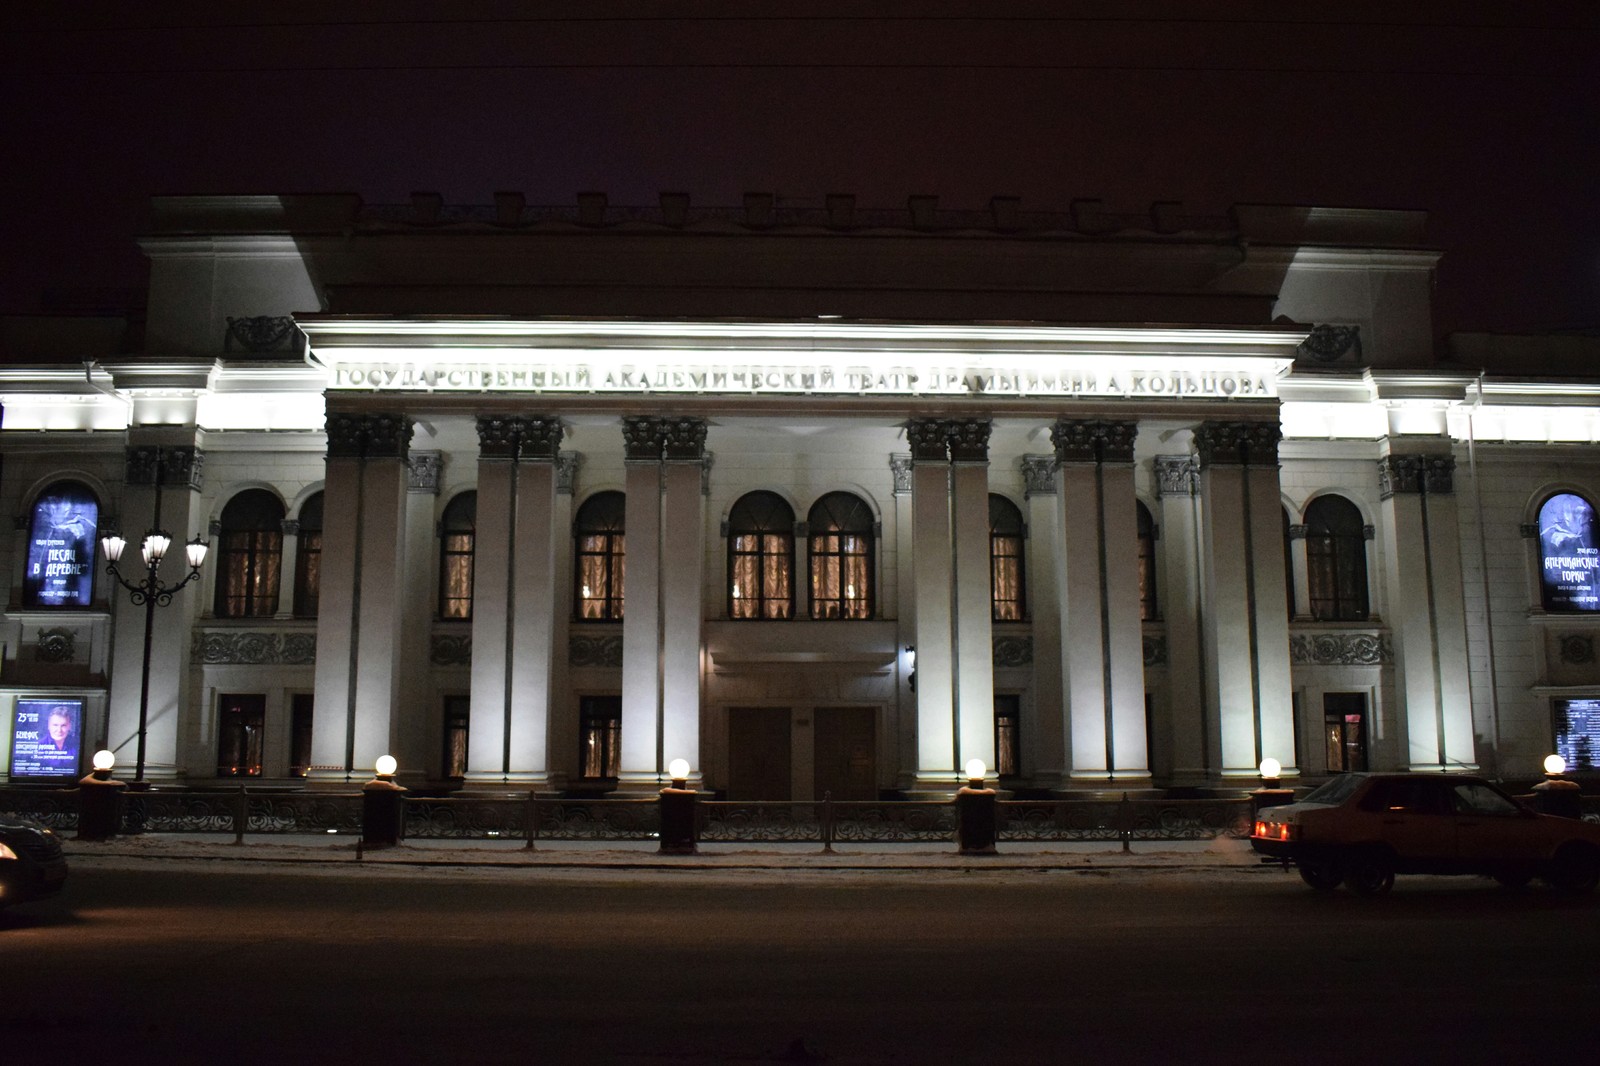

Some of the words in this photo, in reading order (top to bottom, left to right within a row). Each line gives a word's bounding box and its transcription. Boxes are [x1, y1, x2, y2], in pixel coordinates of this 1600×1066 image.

[335, 367, 592, 388] ГОСУДАРСТВЕННЫЙ
[603, 370, 834, 389] АКАДЕМИЧЕСКИЙ
[845, 373, 920, 391] ТЕАТР
[927, 374, 1021, 392] ДРАМЫ
[1131, 376, 1269, 395] КОЛЬЦОВА
[48, 549, 75, 562] МЕСЯЦ
[1545, 557, 1599, 569] АМЕРИКАНСКИЕ
[33, 563, 40, 574] В
[45, 563, 81, 577] ДЕРЕВНЕ
[1562, 570, 1585, 583] ГОРКИ
[18, 713, 27, 723] 25
